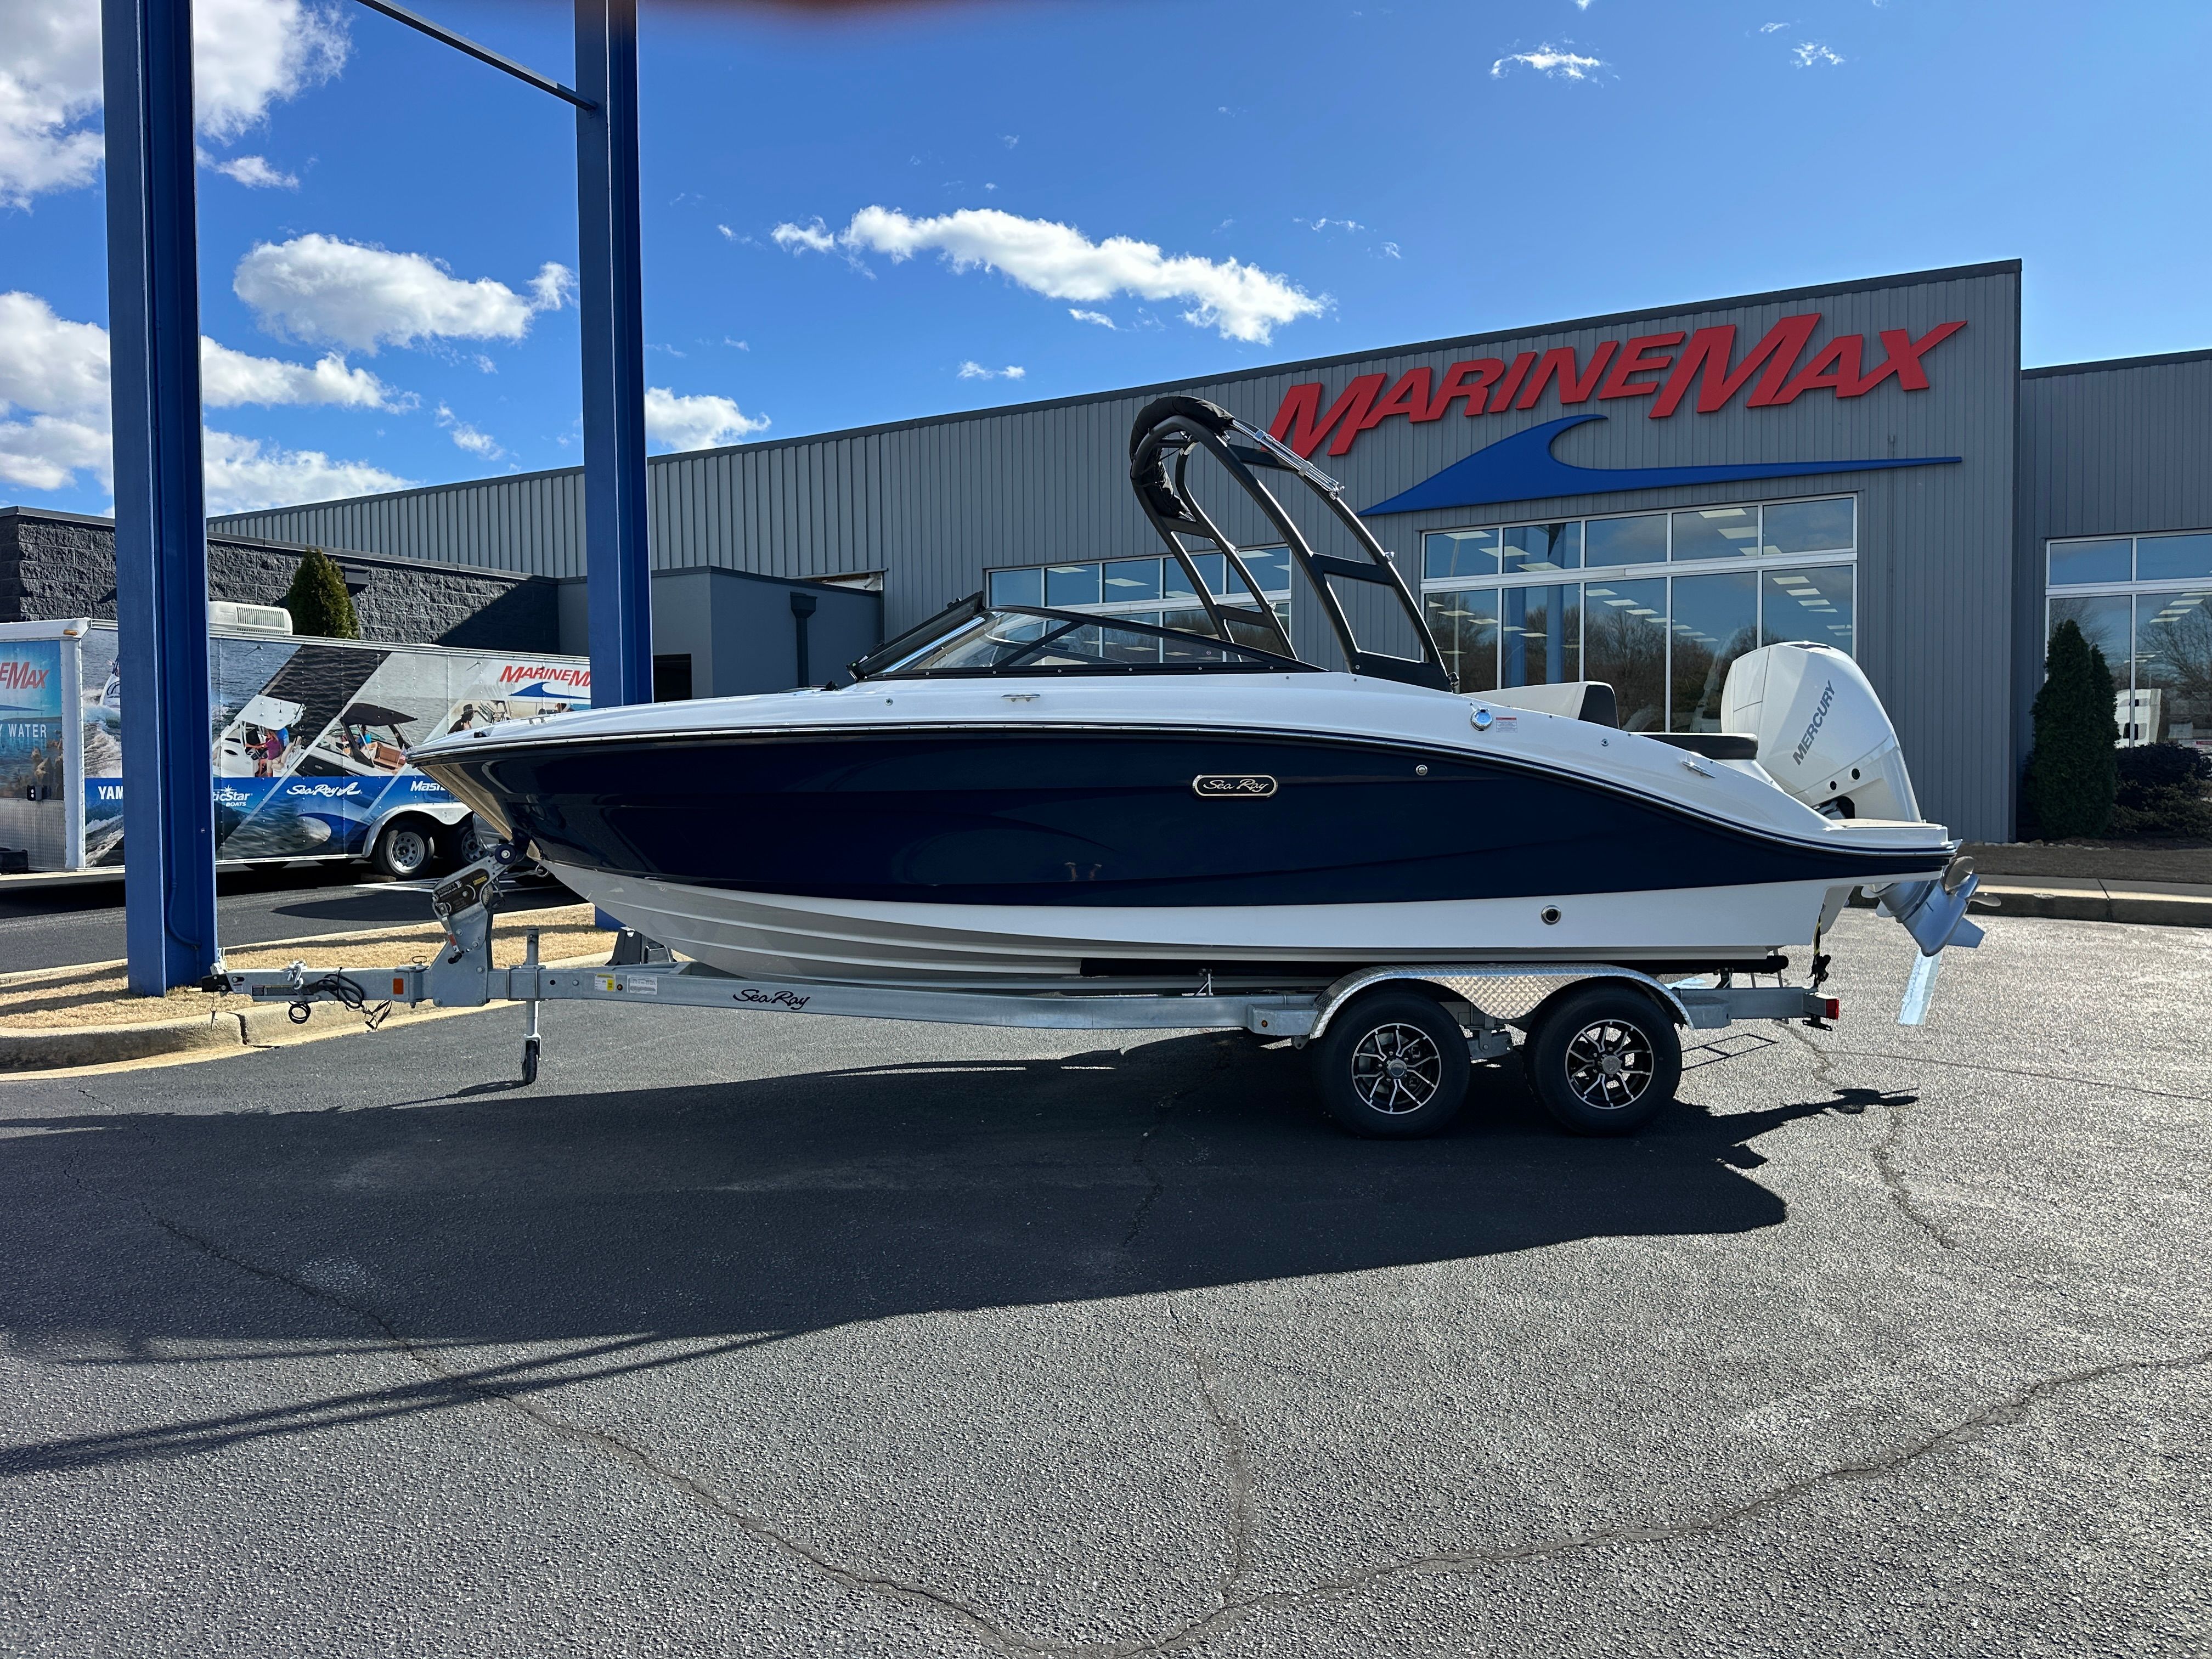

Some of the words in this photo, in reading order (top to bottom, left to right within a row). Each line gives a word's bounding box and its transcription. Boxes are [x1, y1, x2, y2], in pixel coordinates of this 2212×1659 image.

[8, 723, 47, 738] WATER
[1792, 679, 1835, 766] MERCURY
[1203, 780, 1234, 789] Sea
[1236, 778, 1269, 792] Ray
[733, 989, 772, 1003] Sea
[771, 991, 810, 1010] Ray
